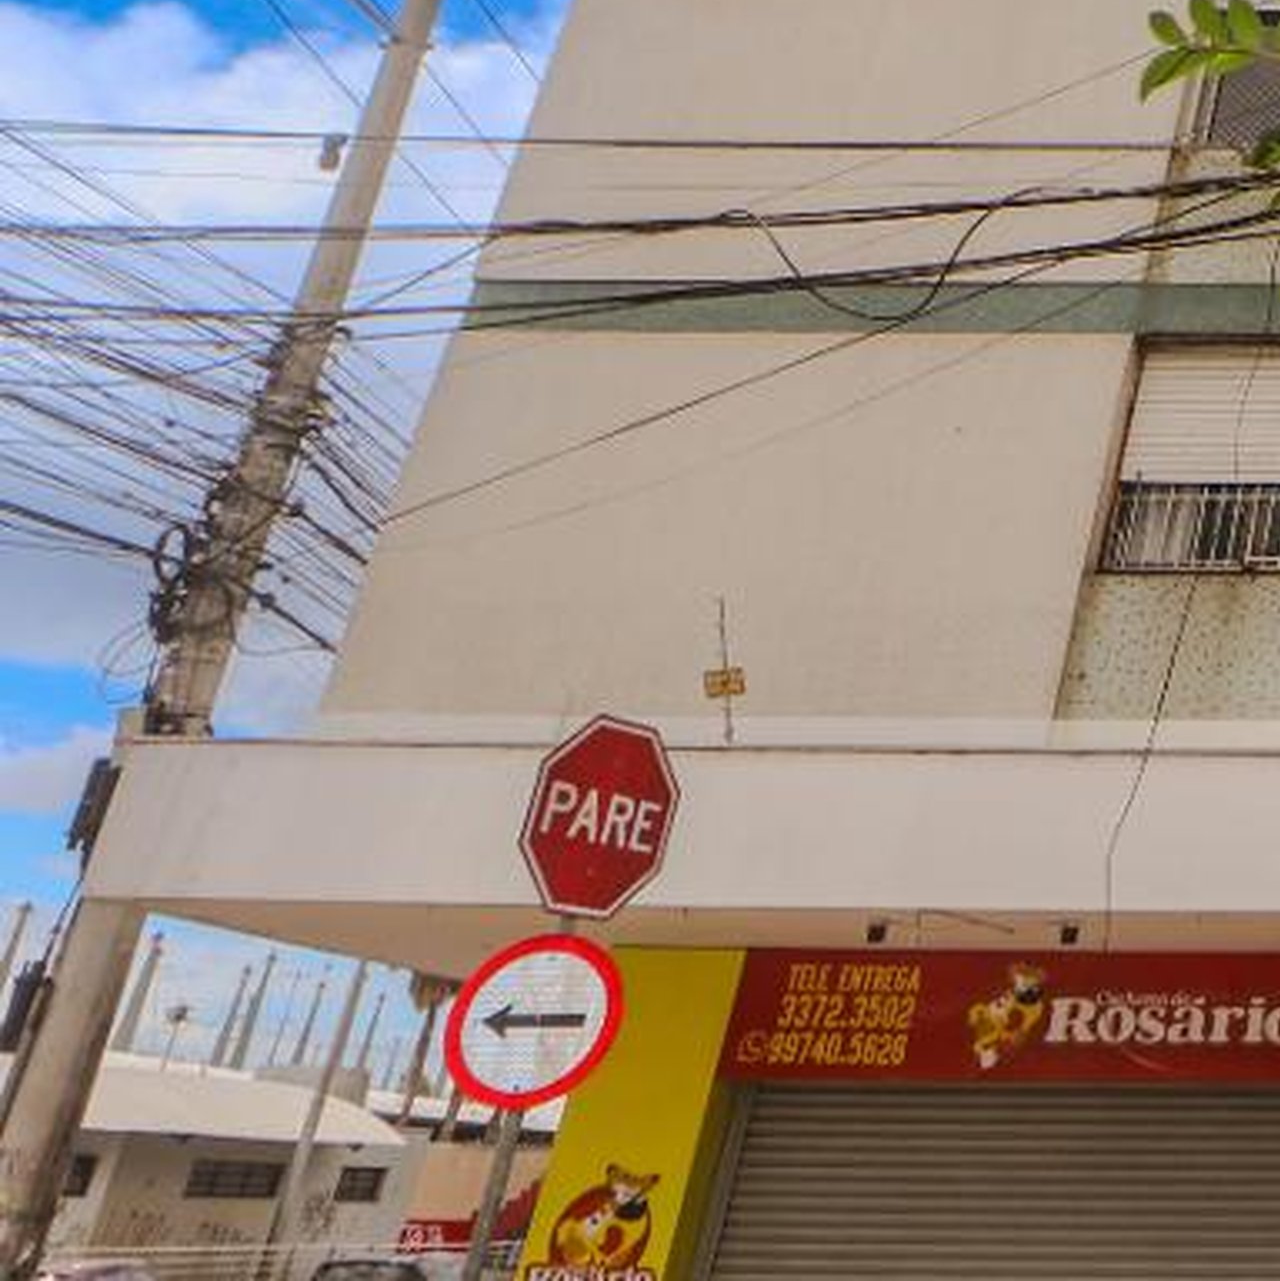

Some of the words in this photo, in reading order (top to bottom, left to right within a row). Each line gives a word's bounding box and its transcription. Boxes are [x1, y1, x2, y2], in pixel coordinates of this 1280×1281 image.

[539, 780, 663, 853] PARE
[787, 963, 832, 992] TELE
[837, 963, 921, 992] ENTREGA
[776, 992, 916, 1029] 3372.3502
